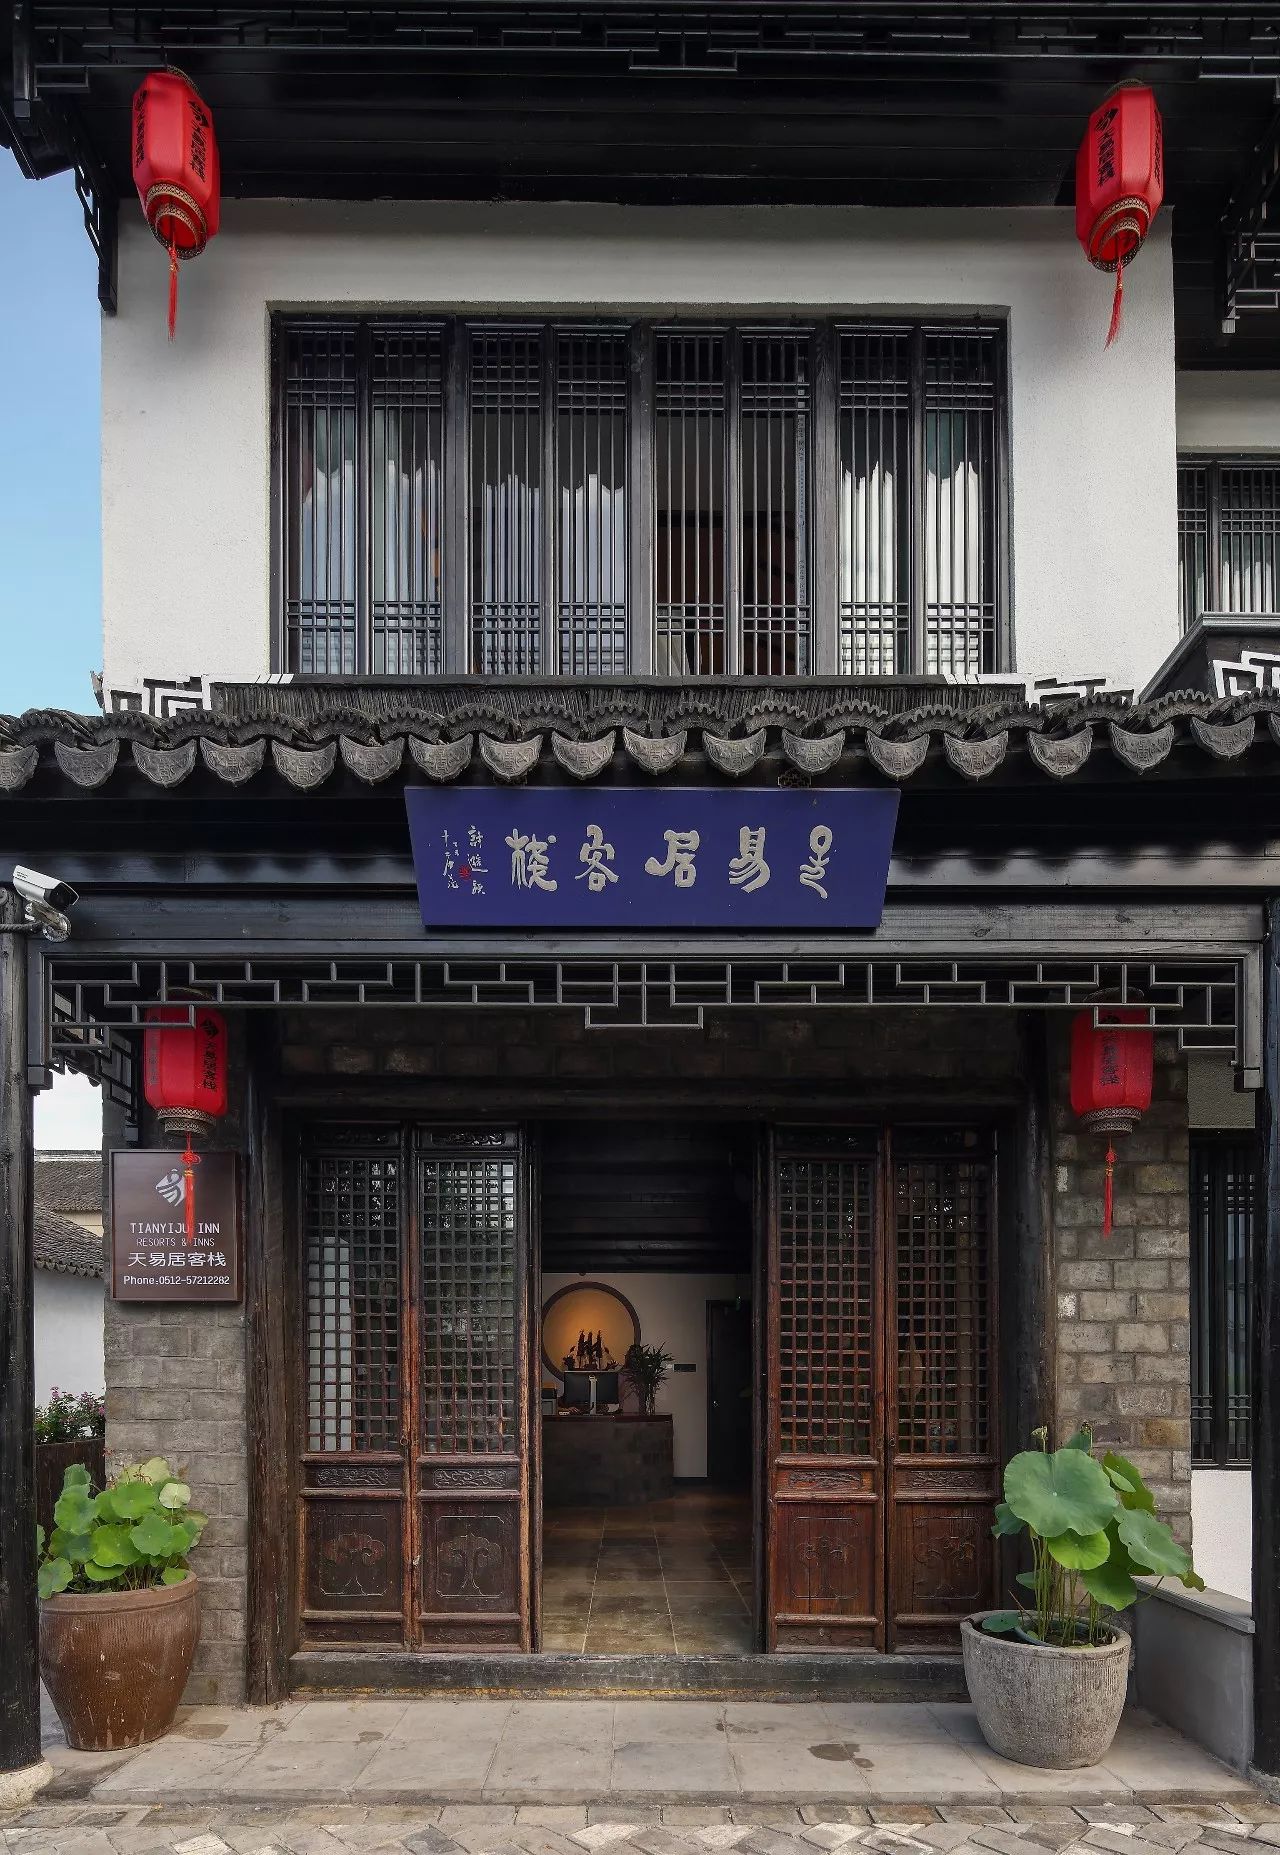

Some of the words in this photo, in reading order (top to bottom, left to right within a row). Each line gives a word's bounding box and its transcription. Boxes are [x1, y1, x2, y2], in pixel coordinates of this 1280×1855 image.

[129, 1222, 190, 1234] TIANYIJU
[198, 1222, 220, 1234] INN
[136, 1237, 176, 1247] RESORTS
[181, 1238, 187, 1246] &
[193, 1237, 215, 1247] INNS
[127, 1251, 227, 1267] 天易居客栈
